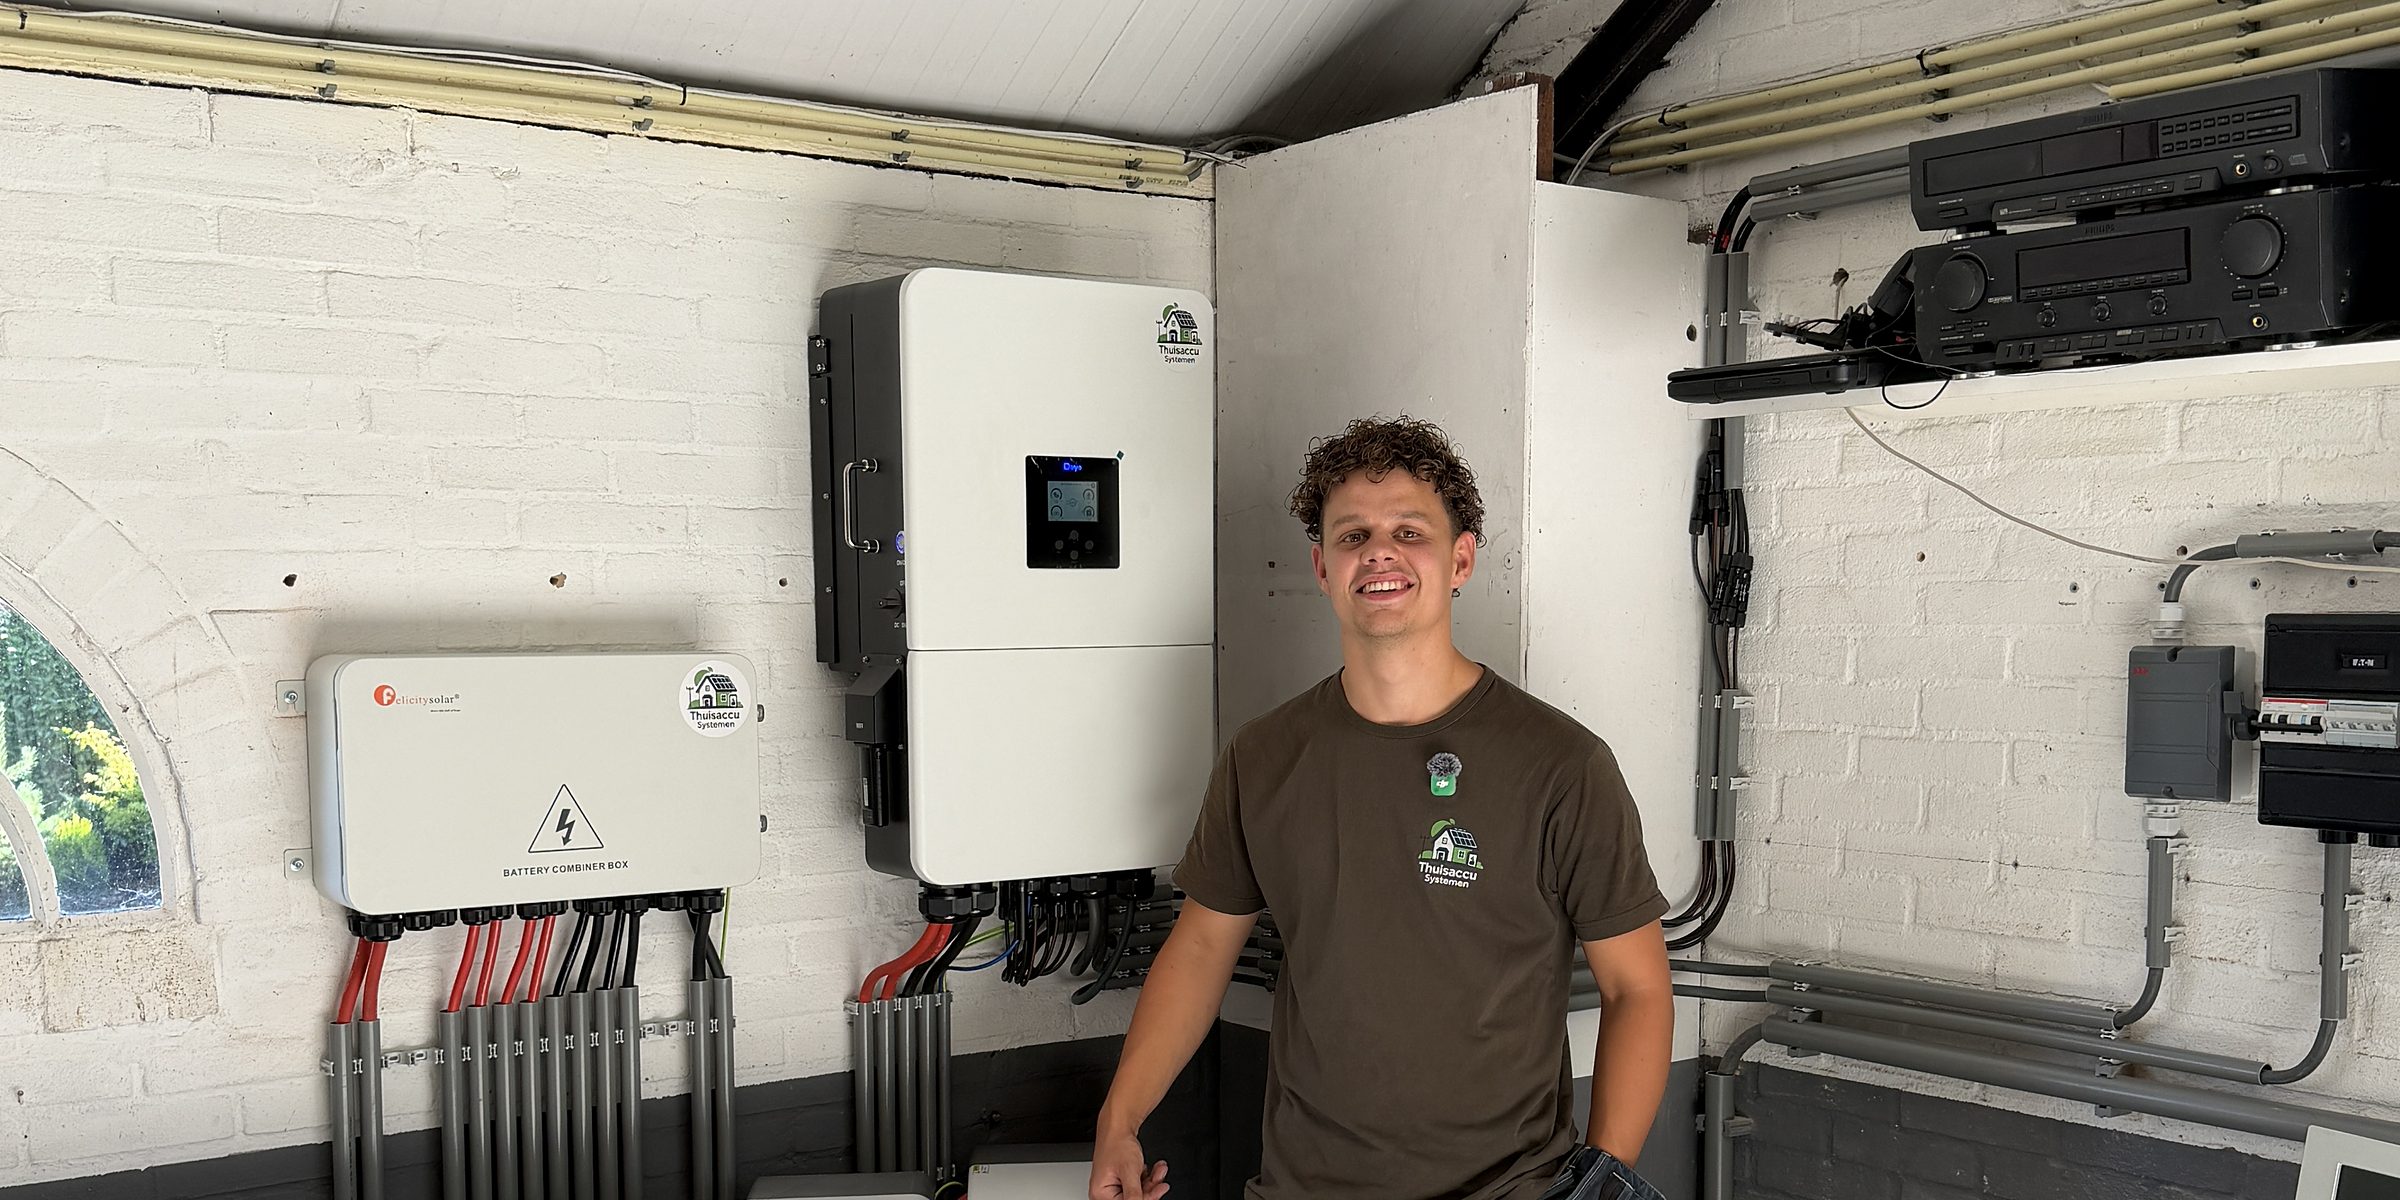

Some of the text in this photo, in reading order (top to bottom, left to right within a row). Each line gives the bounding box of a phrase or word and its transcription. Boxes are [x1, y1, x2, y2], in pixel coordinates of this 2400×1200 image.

[1159, 345, 1200, 355] Thuisaccu
[690, 710, 740, 721] Thuisaccu
[697, 721, 735, 730] Systemen
[503, 860, 629, 877] BATTERY COMBINER BOX
[1419, 861, 1477, 881] Thuisaccu
[1424, 873, 1470, 888] Systemen
